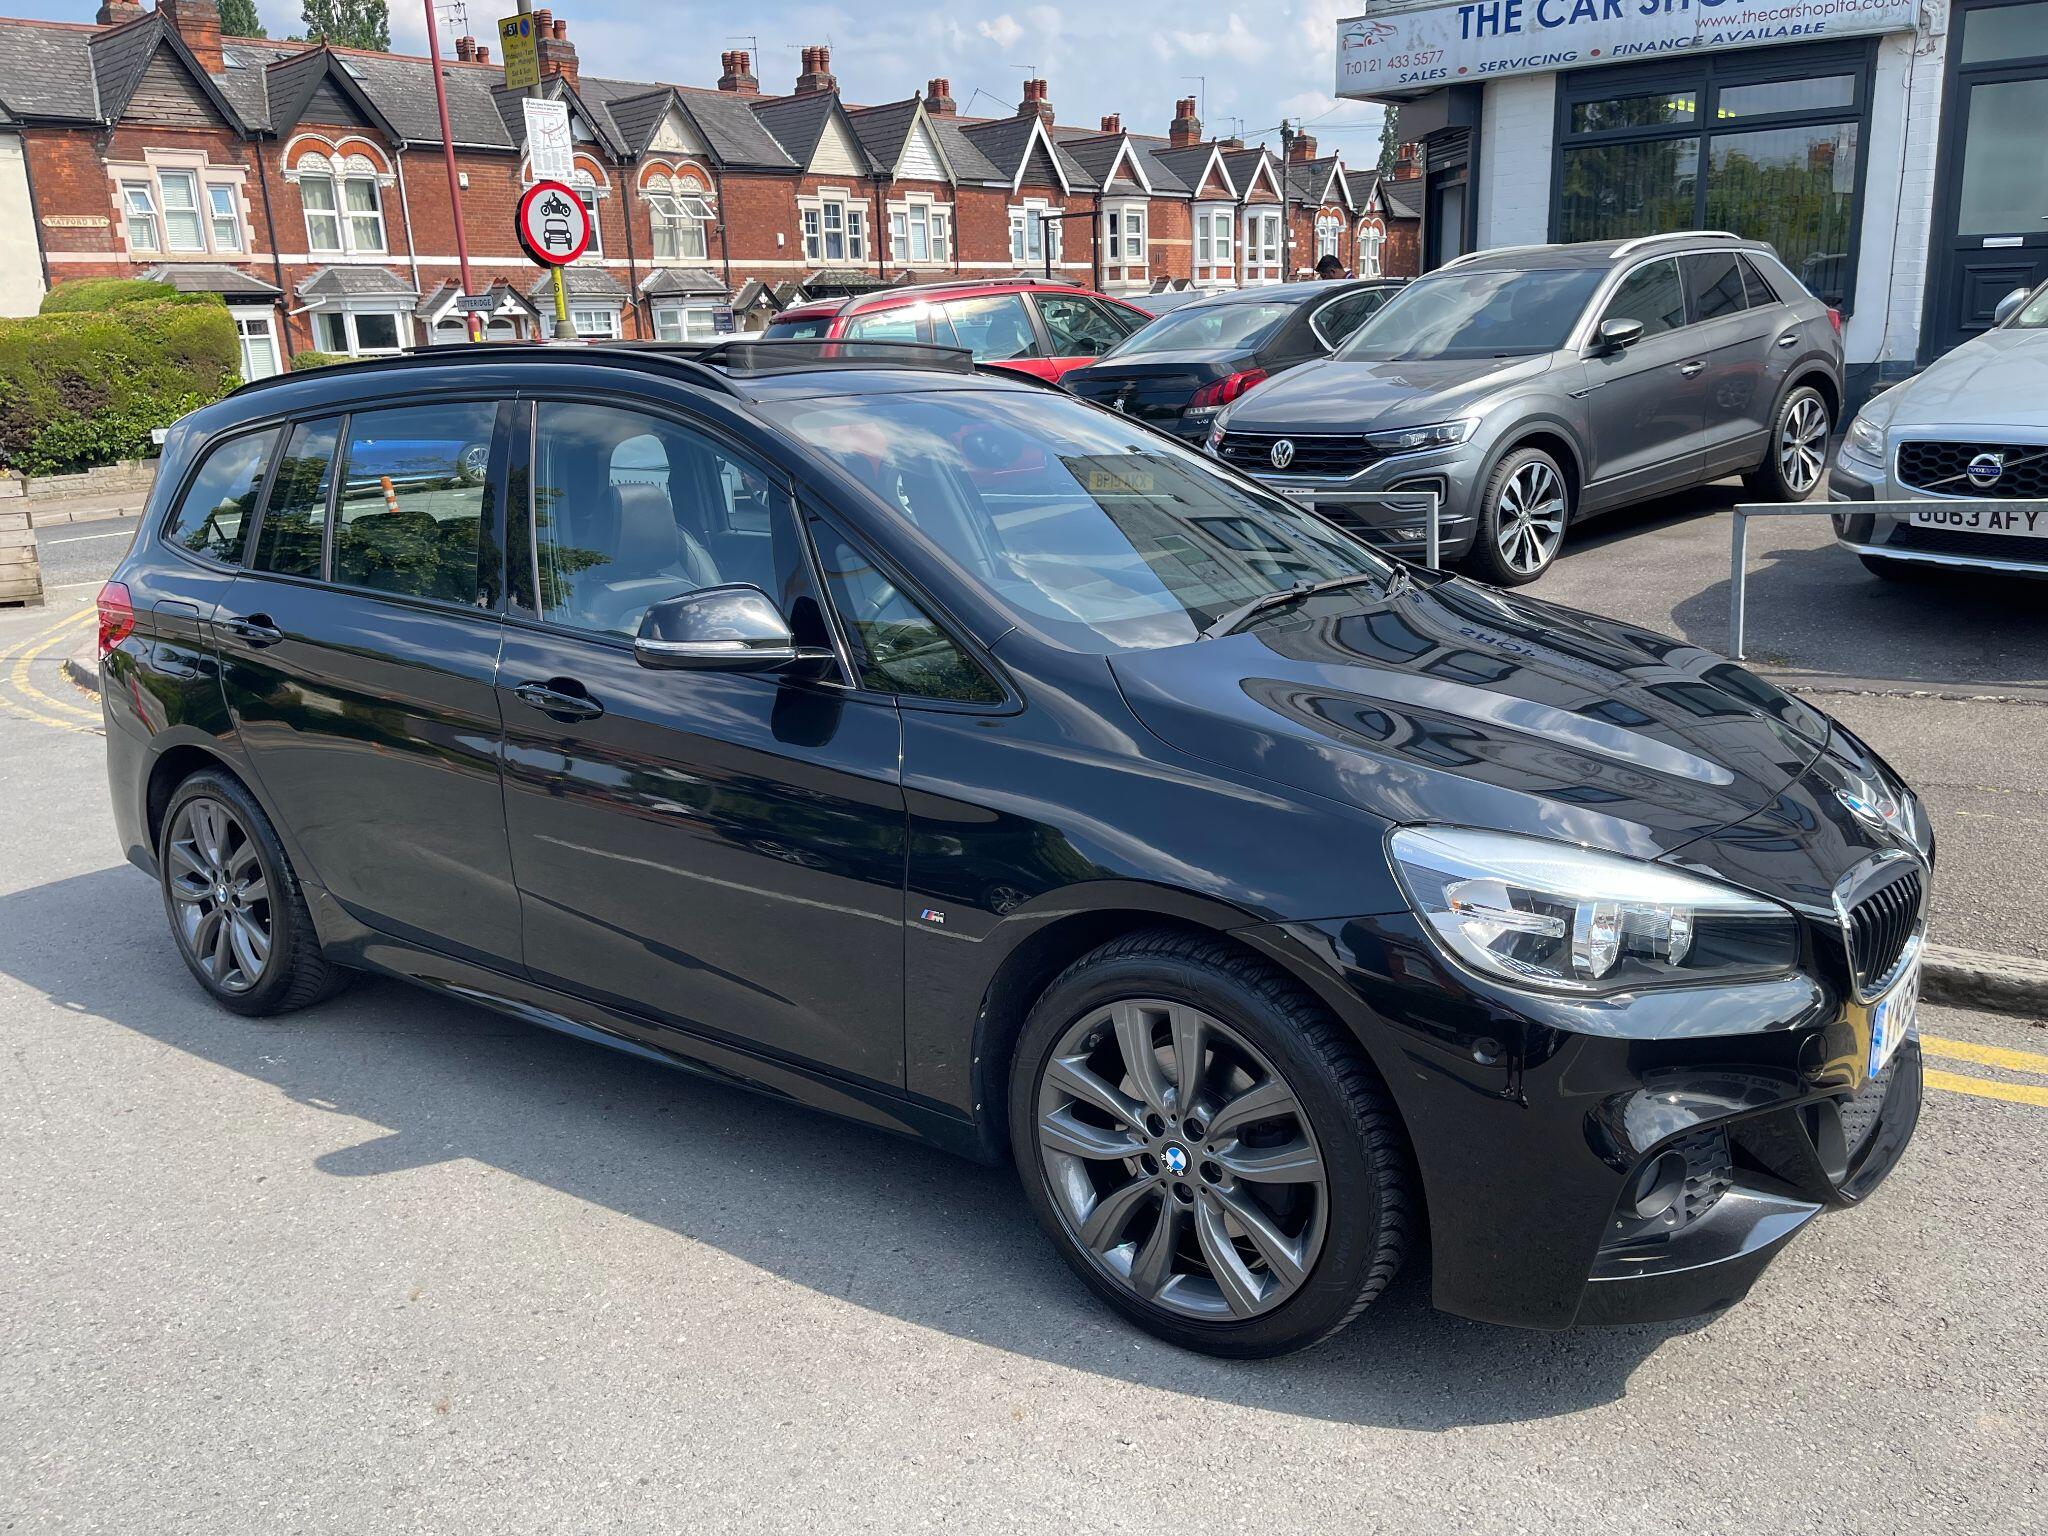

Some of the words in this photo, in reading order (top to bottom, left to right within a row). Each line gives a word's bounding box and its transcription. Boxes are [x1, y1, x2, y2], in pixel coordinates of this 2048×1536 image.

[1458, 0, 1522, 39] THE
[1537, 0, 1623, 28] CAR
[1695, 0, 1910, 28] www.thecarshopltd.co.u
[1345, 58, 1382, 75] T:0121
[1387, 55, 1409, 69] 433
[1413, 50, 1444, 66] 5577
[1398, 68, 1447, 83] SALES
[1478, 51, 1578, 73] SERVICING
[1612, 36, 1703, 56] FINANCE
[1710, 22, 1826, 44] AVAILABLE
[50, 218, 88, 226] WATFORD
[553, 283, 560, 293] 6
[1969, 466, 2000, 474] VOLVO
